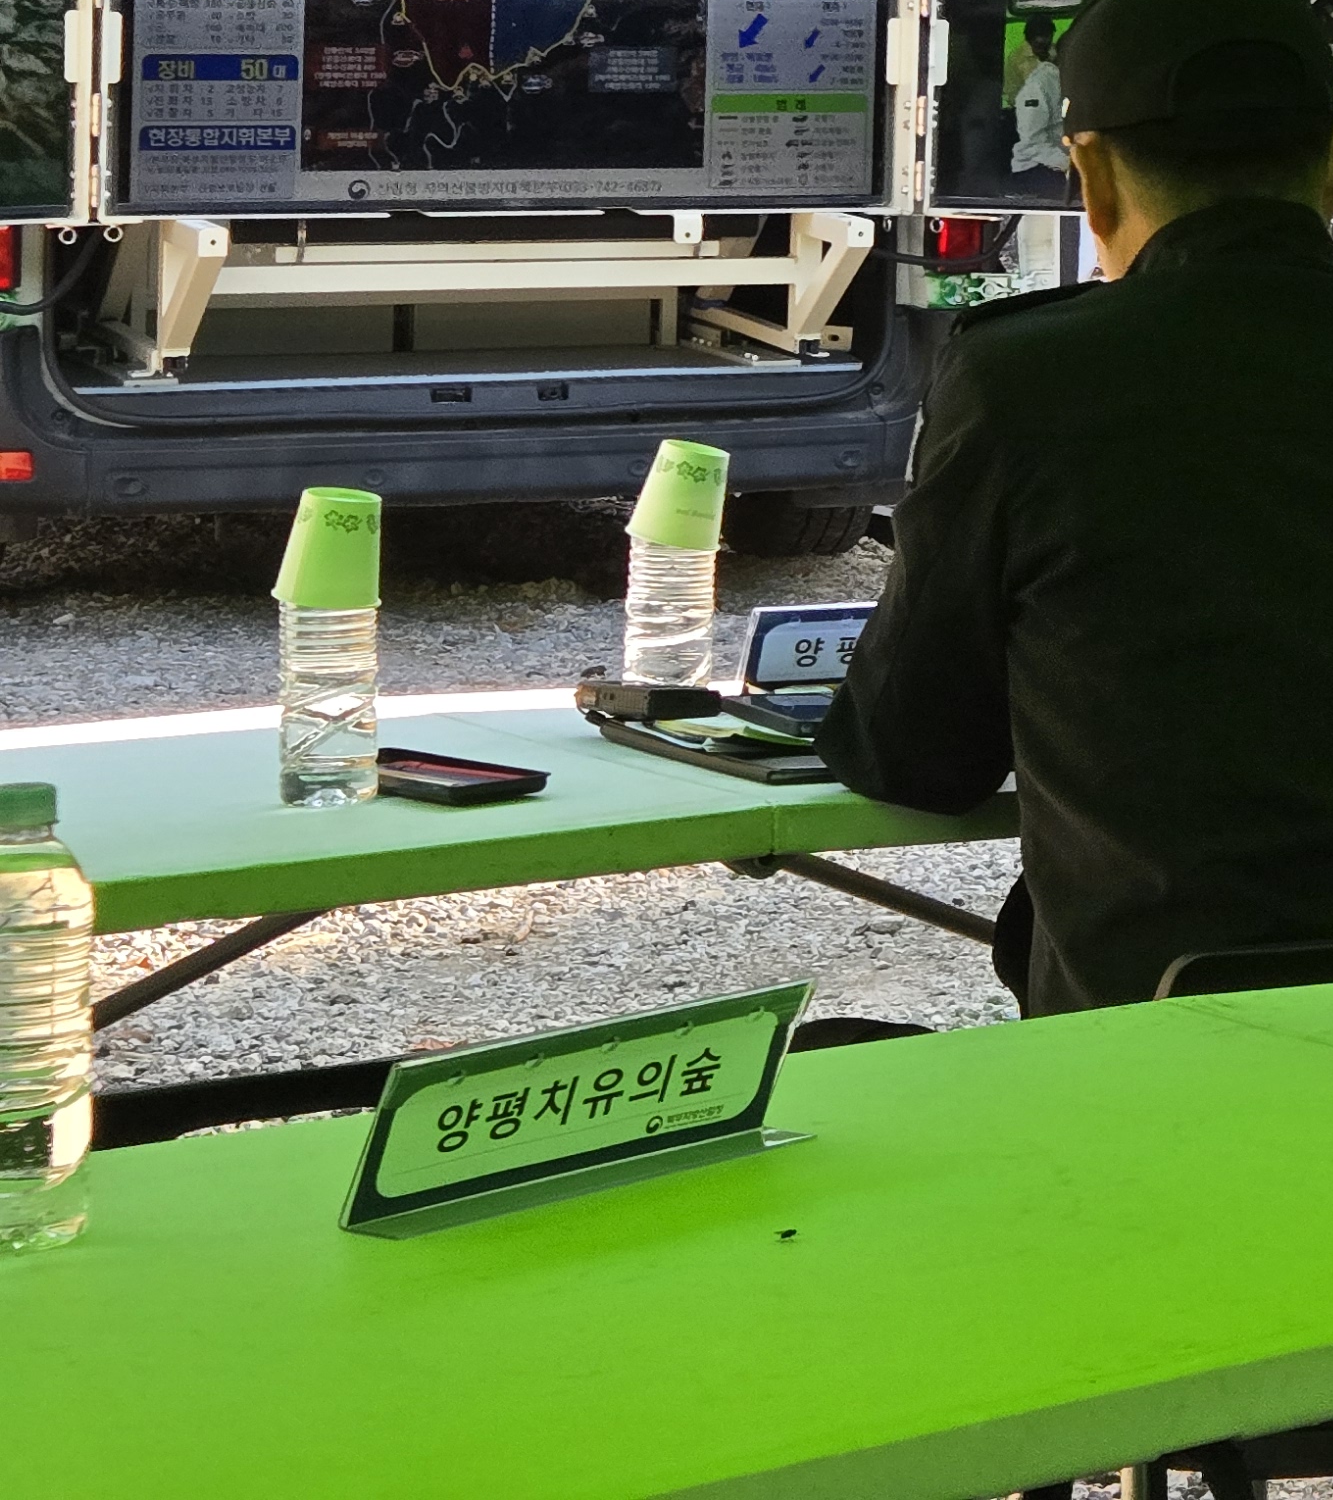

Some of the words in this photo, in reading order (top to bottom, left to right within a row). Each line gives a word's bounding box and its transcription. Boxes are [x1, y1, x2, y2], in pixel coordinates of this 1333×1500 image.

[158, 60, 195, 80] 장비
[240, 58, 268, 80] 50
[149, 128, 291, 147] 현장통합지휘본부
[436, 1046, 723, 1153] 양평치유의숲
